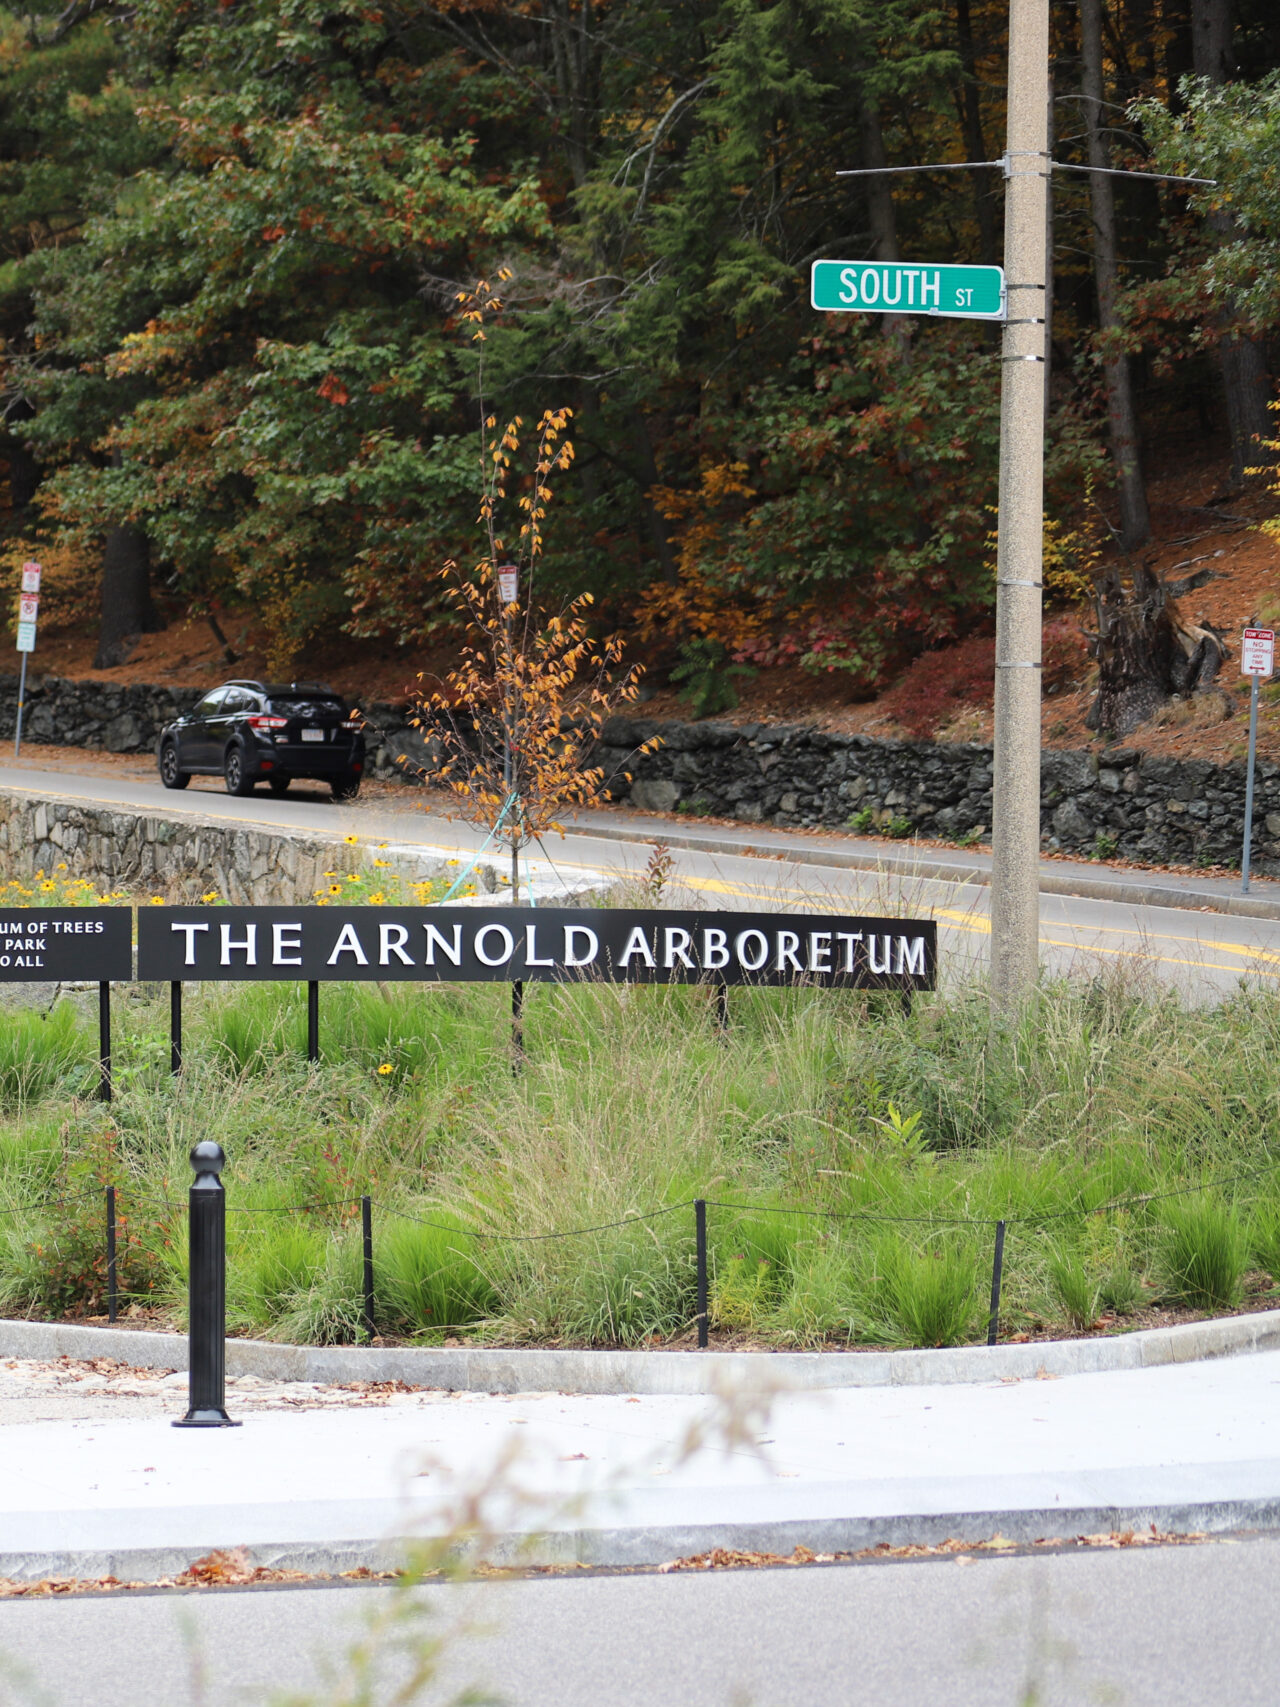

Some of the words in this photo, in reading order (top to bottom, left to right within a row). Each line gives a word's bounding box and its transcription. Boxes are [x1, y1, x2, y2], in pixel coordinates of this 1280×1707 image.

[838, 267, 941, 306] SOUTH
[955, 288, 974, 307] ST
[28, 921, 48, 934] OF
[52, 921, 104, 934] TREES
[5, 938, 46, 951] PARK
[171, 922, 302, 967] THE
[326, 923, 599, 968] ARNOLD
[616, 926, 926, 978] ARBORETUM
[14, 955, 44, 967] ALL
